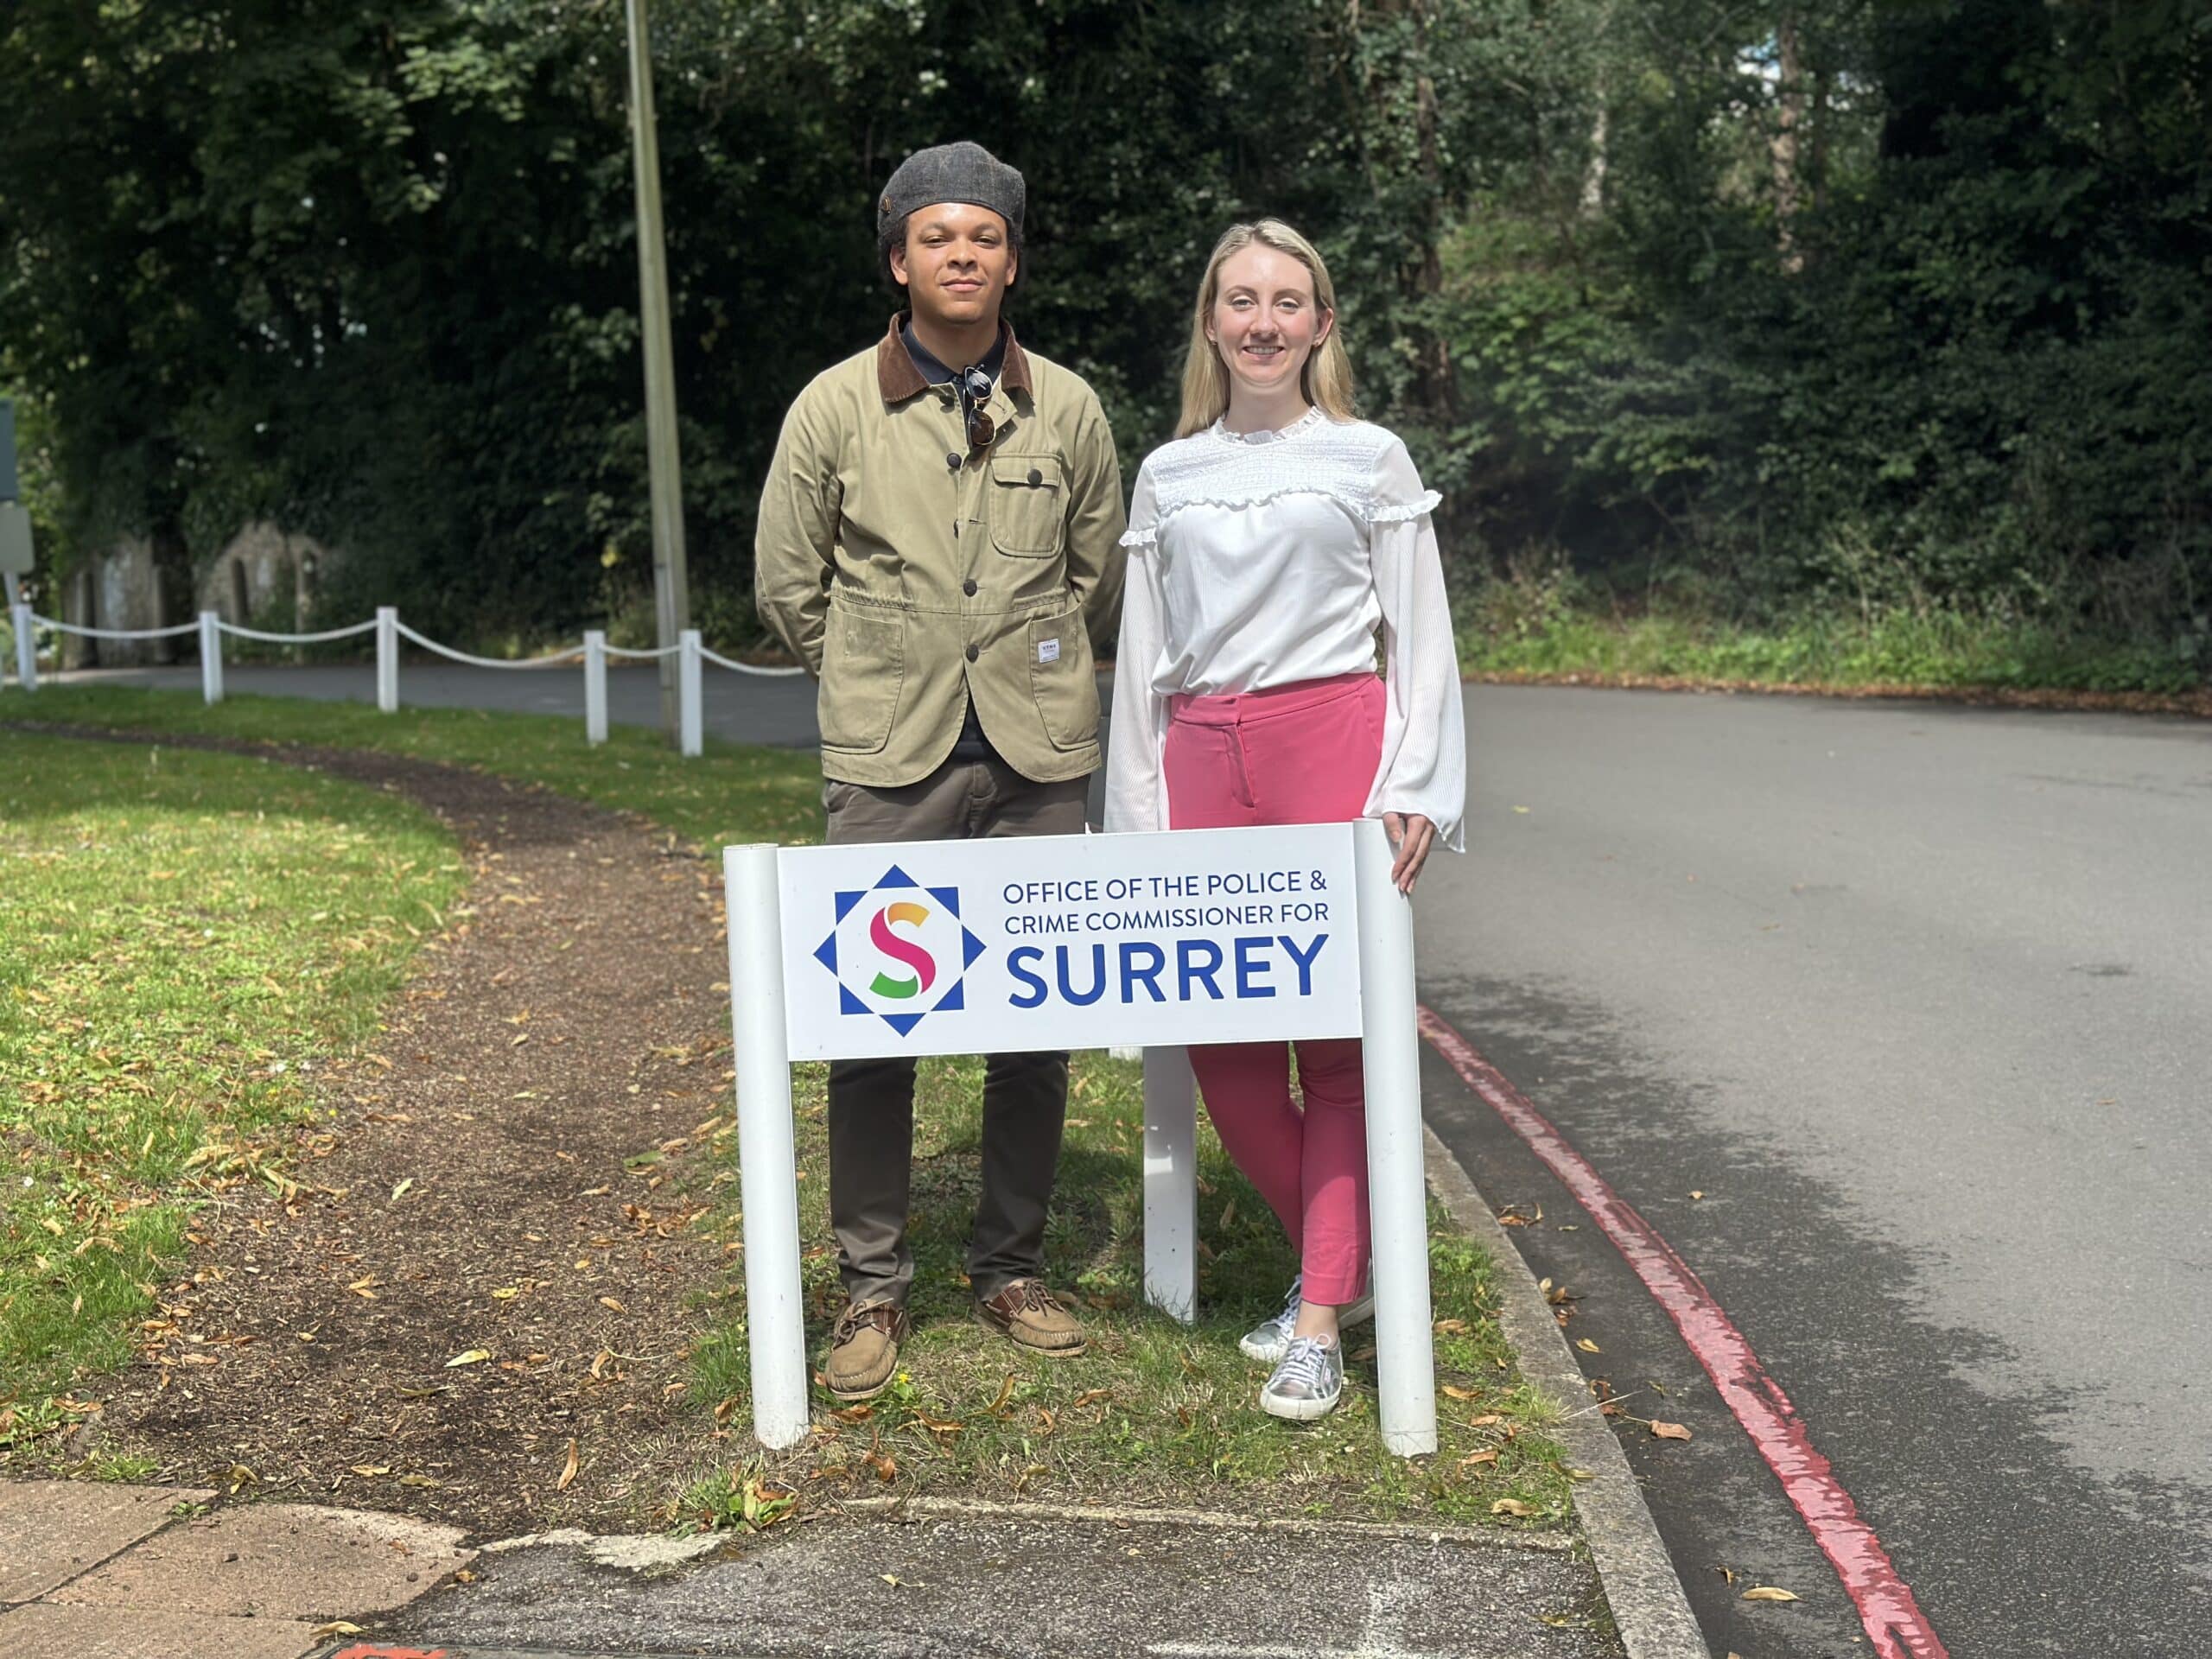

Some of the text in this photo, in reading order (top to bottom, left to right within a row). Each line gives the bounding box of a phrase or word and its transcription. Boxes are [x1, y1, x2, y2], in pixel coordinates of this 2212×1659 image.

[1003, 869, 1327, 905] OFFICE OF THE POLICE &
[1005, 902, 1328, 935] CRIME COMMISSIONER FOR
[870, 902, 937, 998] S
[1006, 933, 1329, 1009] SURREY
